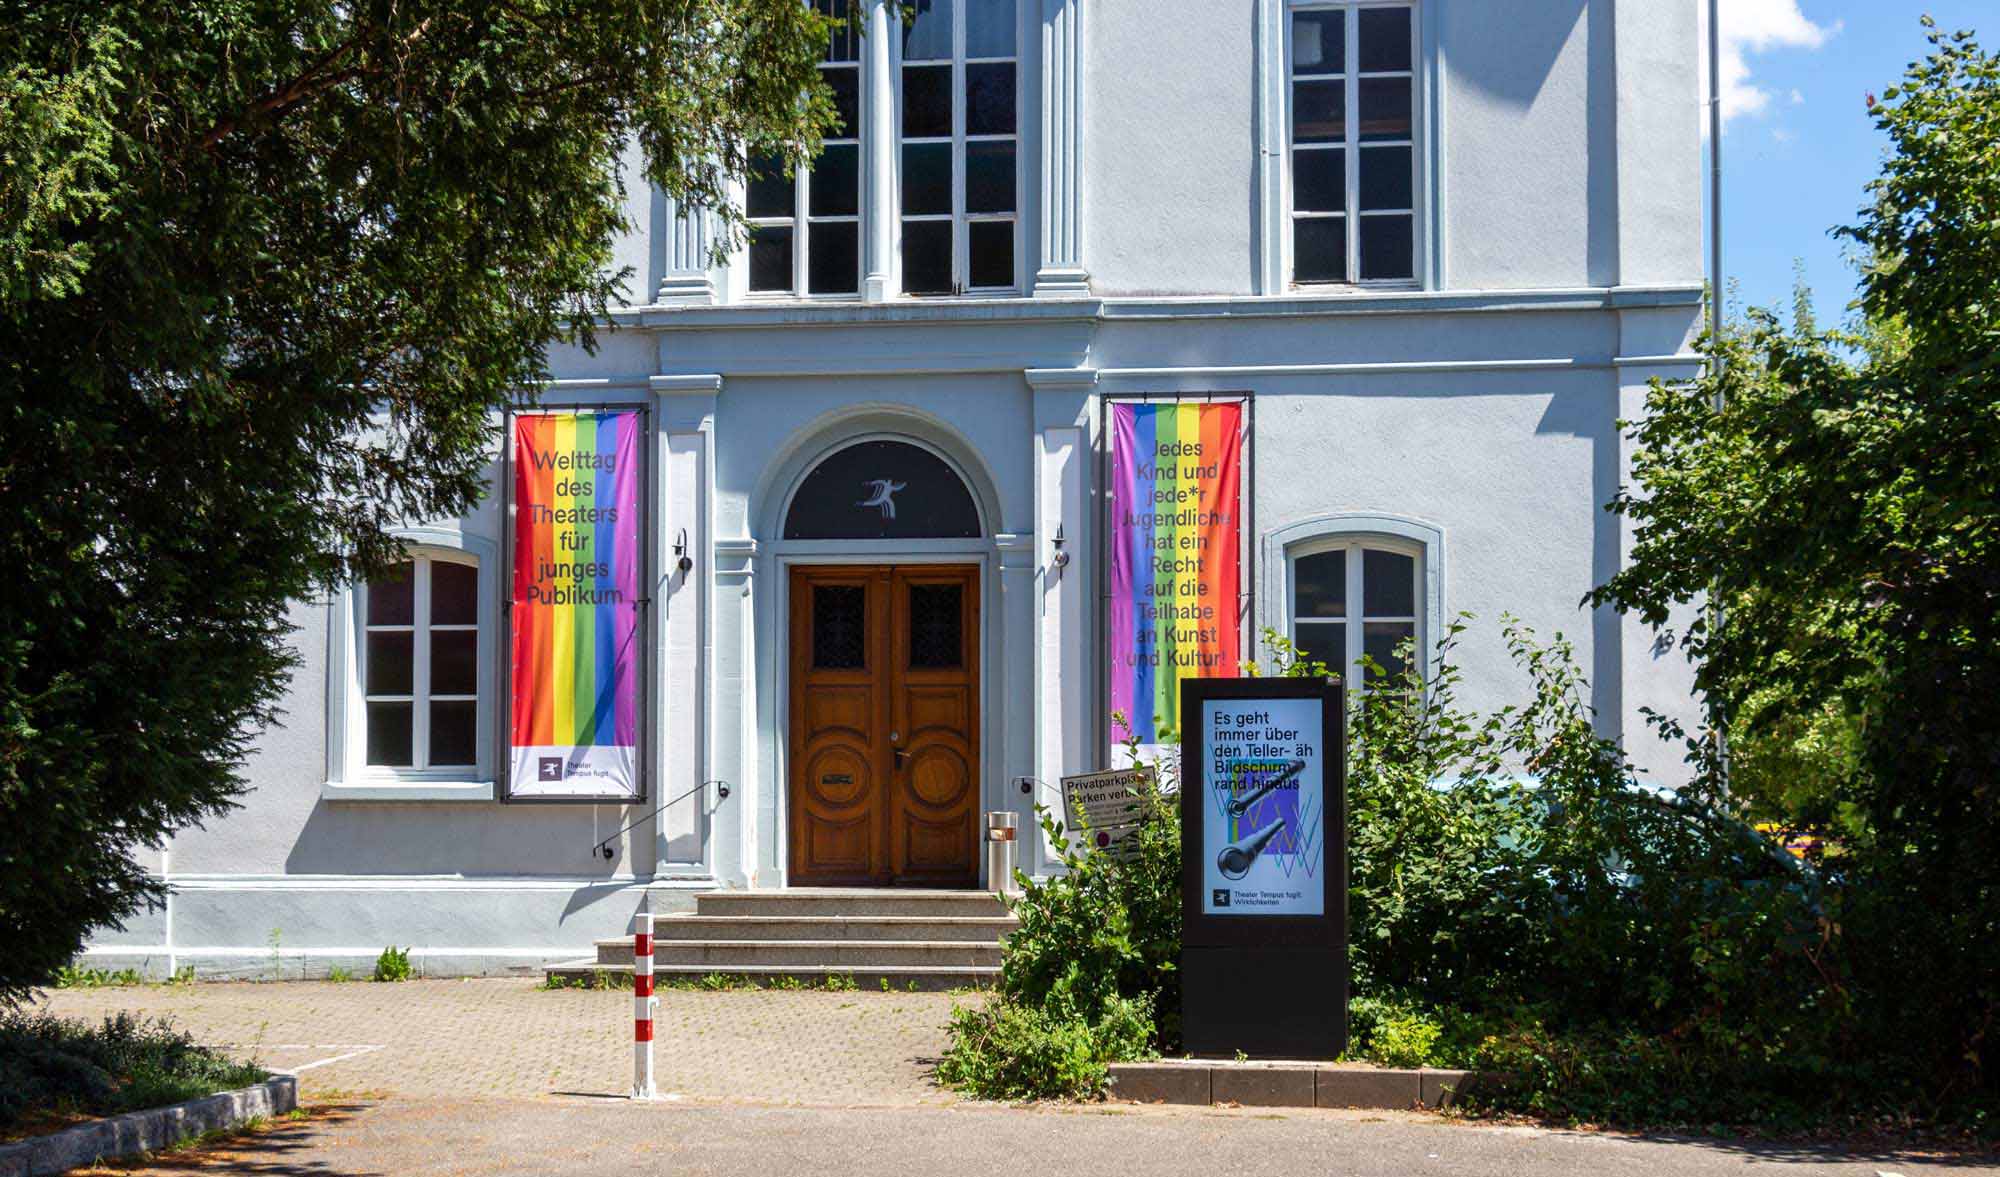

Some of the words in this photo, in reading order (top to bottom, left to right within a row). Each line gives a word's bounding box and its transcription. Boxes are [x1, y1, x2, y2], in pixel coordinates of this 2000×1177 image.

[1152, 440, 1203, 456] Jedes
[533, 451, 617, 472] Welttag
[1137, 464, 1177, 479] Kind
[1184, 462, 1218, 479] und
[556, 477, 593, 496] des
[530, 504, 618, 524] Theaters
[1122, 509, 1231, 529] Jugendliche
[560, 531, 589, 550] für
[1145, 532, 1176, 549] hat
[1180, 532, 1208, 549] ein
[537, 558, 609, 582] junges
[1151, 556, 1204, 573] Recht
[527, 585, 624, 605] Publikum
[1144, 579, 1174, 596] auf
[1179, 579, 1208, 596] die
[1137, 602, 1213, 619] Teilhabe
[1136, 630, 1157, 643] an
[1165, 627, 1216, 643] Kunst
[1126, 651, 1160, 667] und
[1167, 650, 1226, 667] Kultur!
[1214, 712, 1231, 724] Es
[1236, 711, 1269, 727] geht
[1215, 728, 1260, 740] immer
[1265, 727, 1298, 740] über
[1214, 744, 1241, 757] den
[1246, 744, 1290, 757] Teller-
[1295, 743, 1313, 757] äh
[567, 760, 591, 769] Theater
[1215, 776, 1246, 790] rand
[1260, 891, 1284, 899] Tempus
